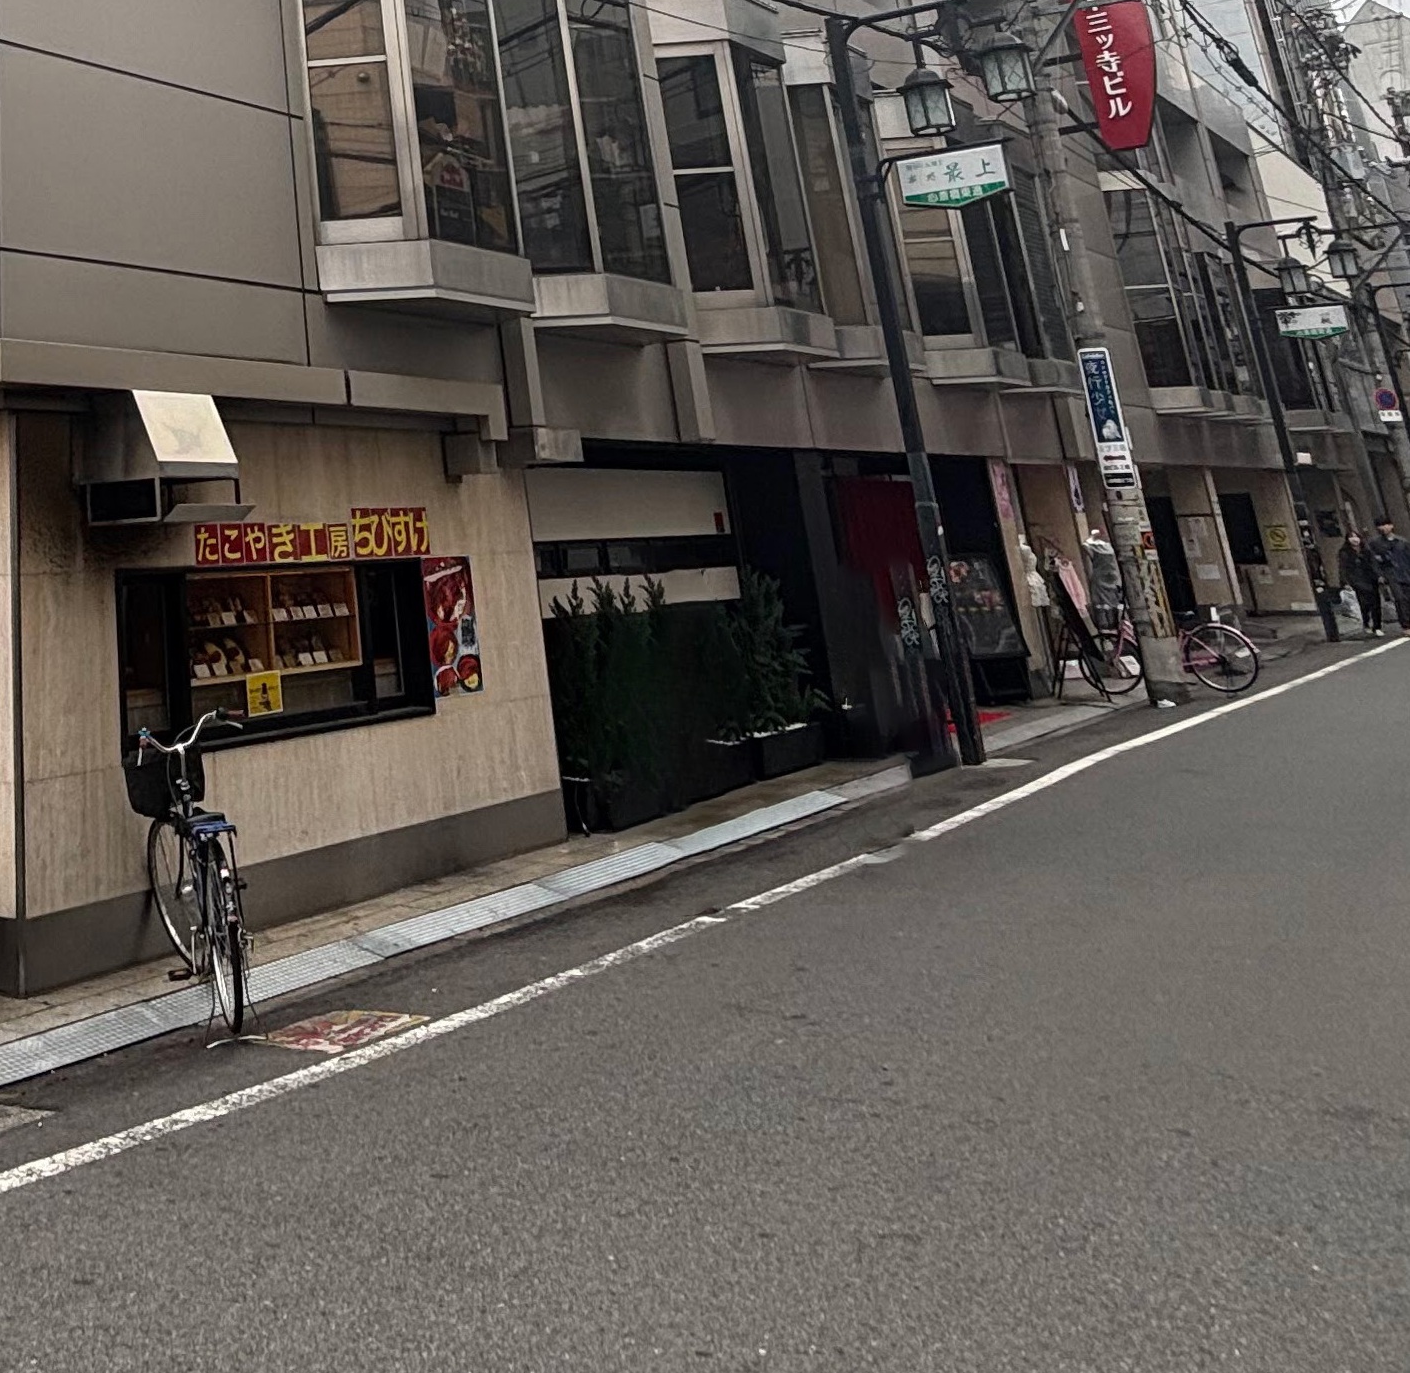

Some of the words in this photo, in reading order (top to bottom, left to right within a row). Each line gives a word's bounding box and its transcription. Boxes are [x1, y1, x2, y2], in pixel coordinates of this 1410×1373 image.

[196, 523, 350, 562] たこやき工房
[351, 509, 429, 556] ちびすけ
